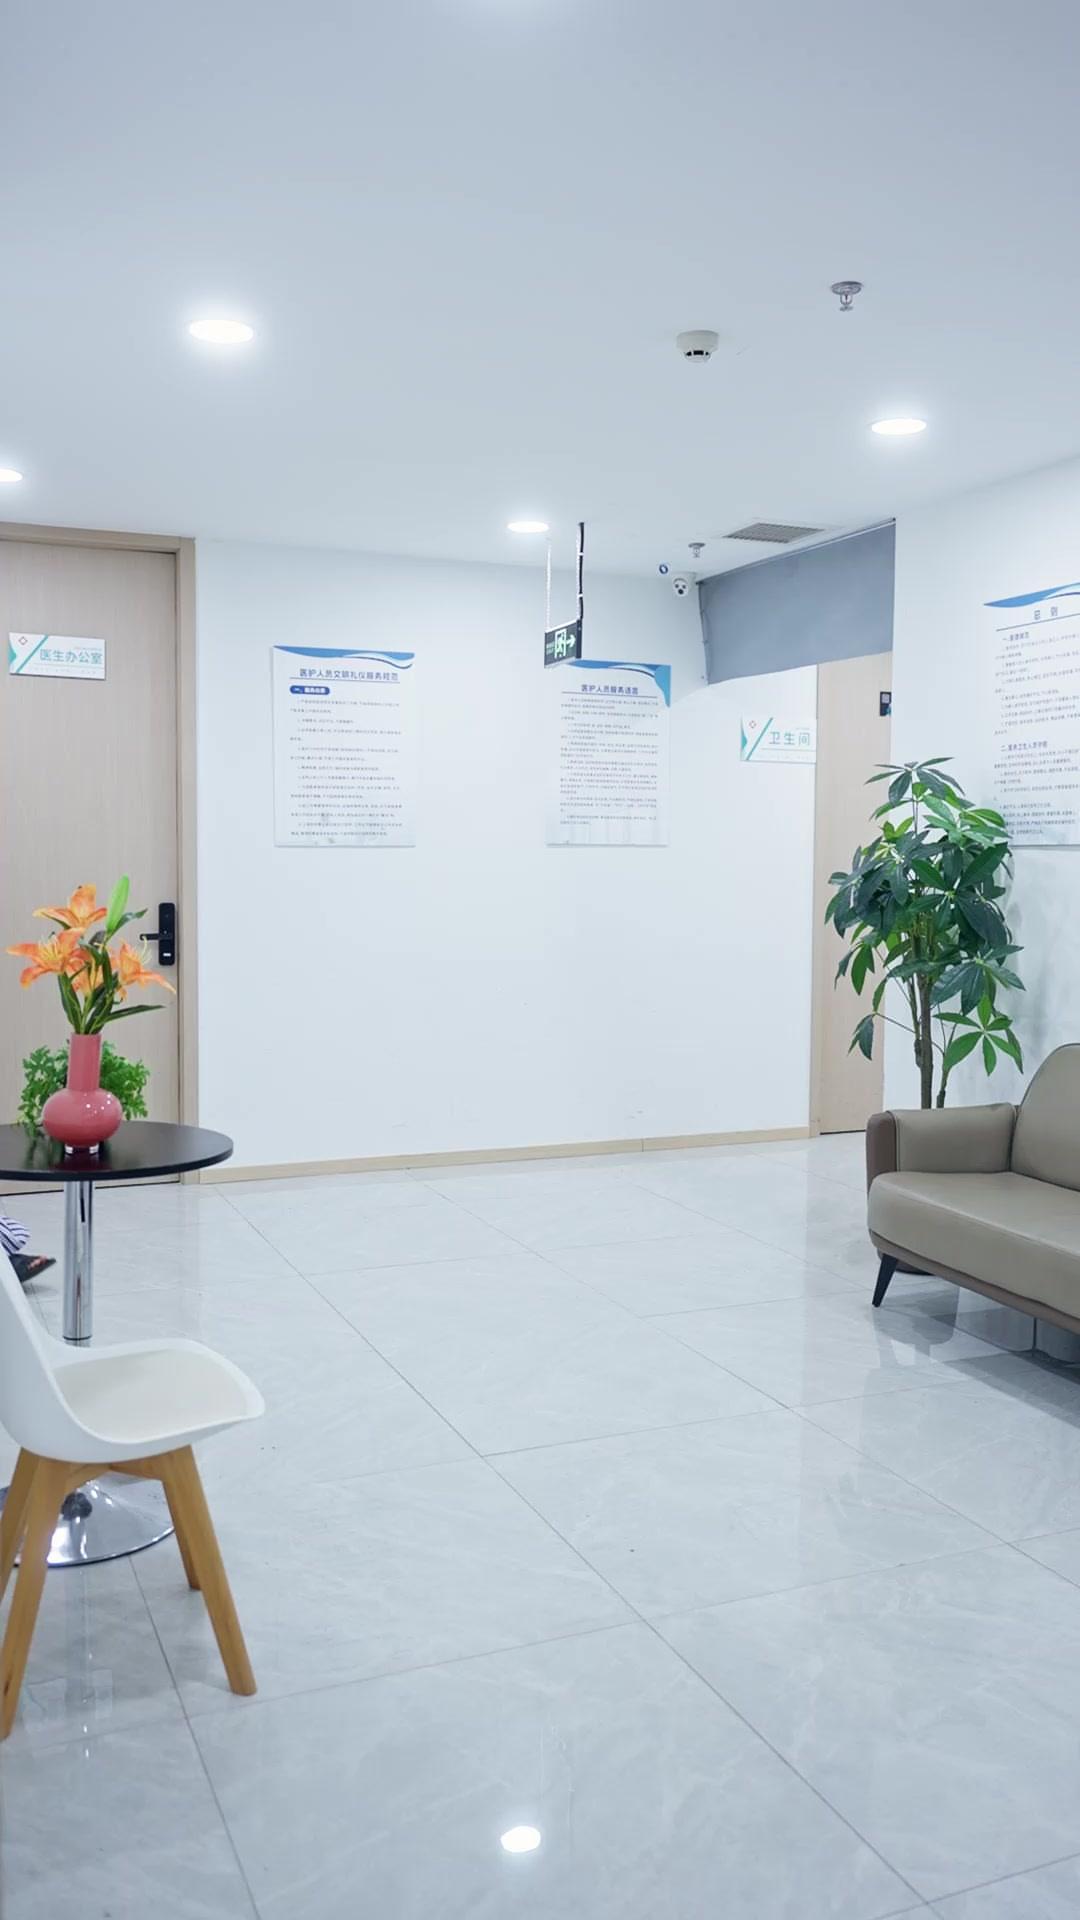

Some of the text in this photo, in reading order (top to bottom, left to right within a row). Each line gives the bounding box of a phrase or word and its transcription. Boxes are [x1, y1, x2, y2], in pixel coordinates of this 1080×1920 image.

[39, 648, 103, 665] 医生办公室
[768, 730, 811, 747] 卫生间
